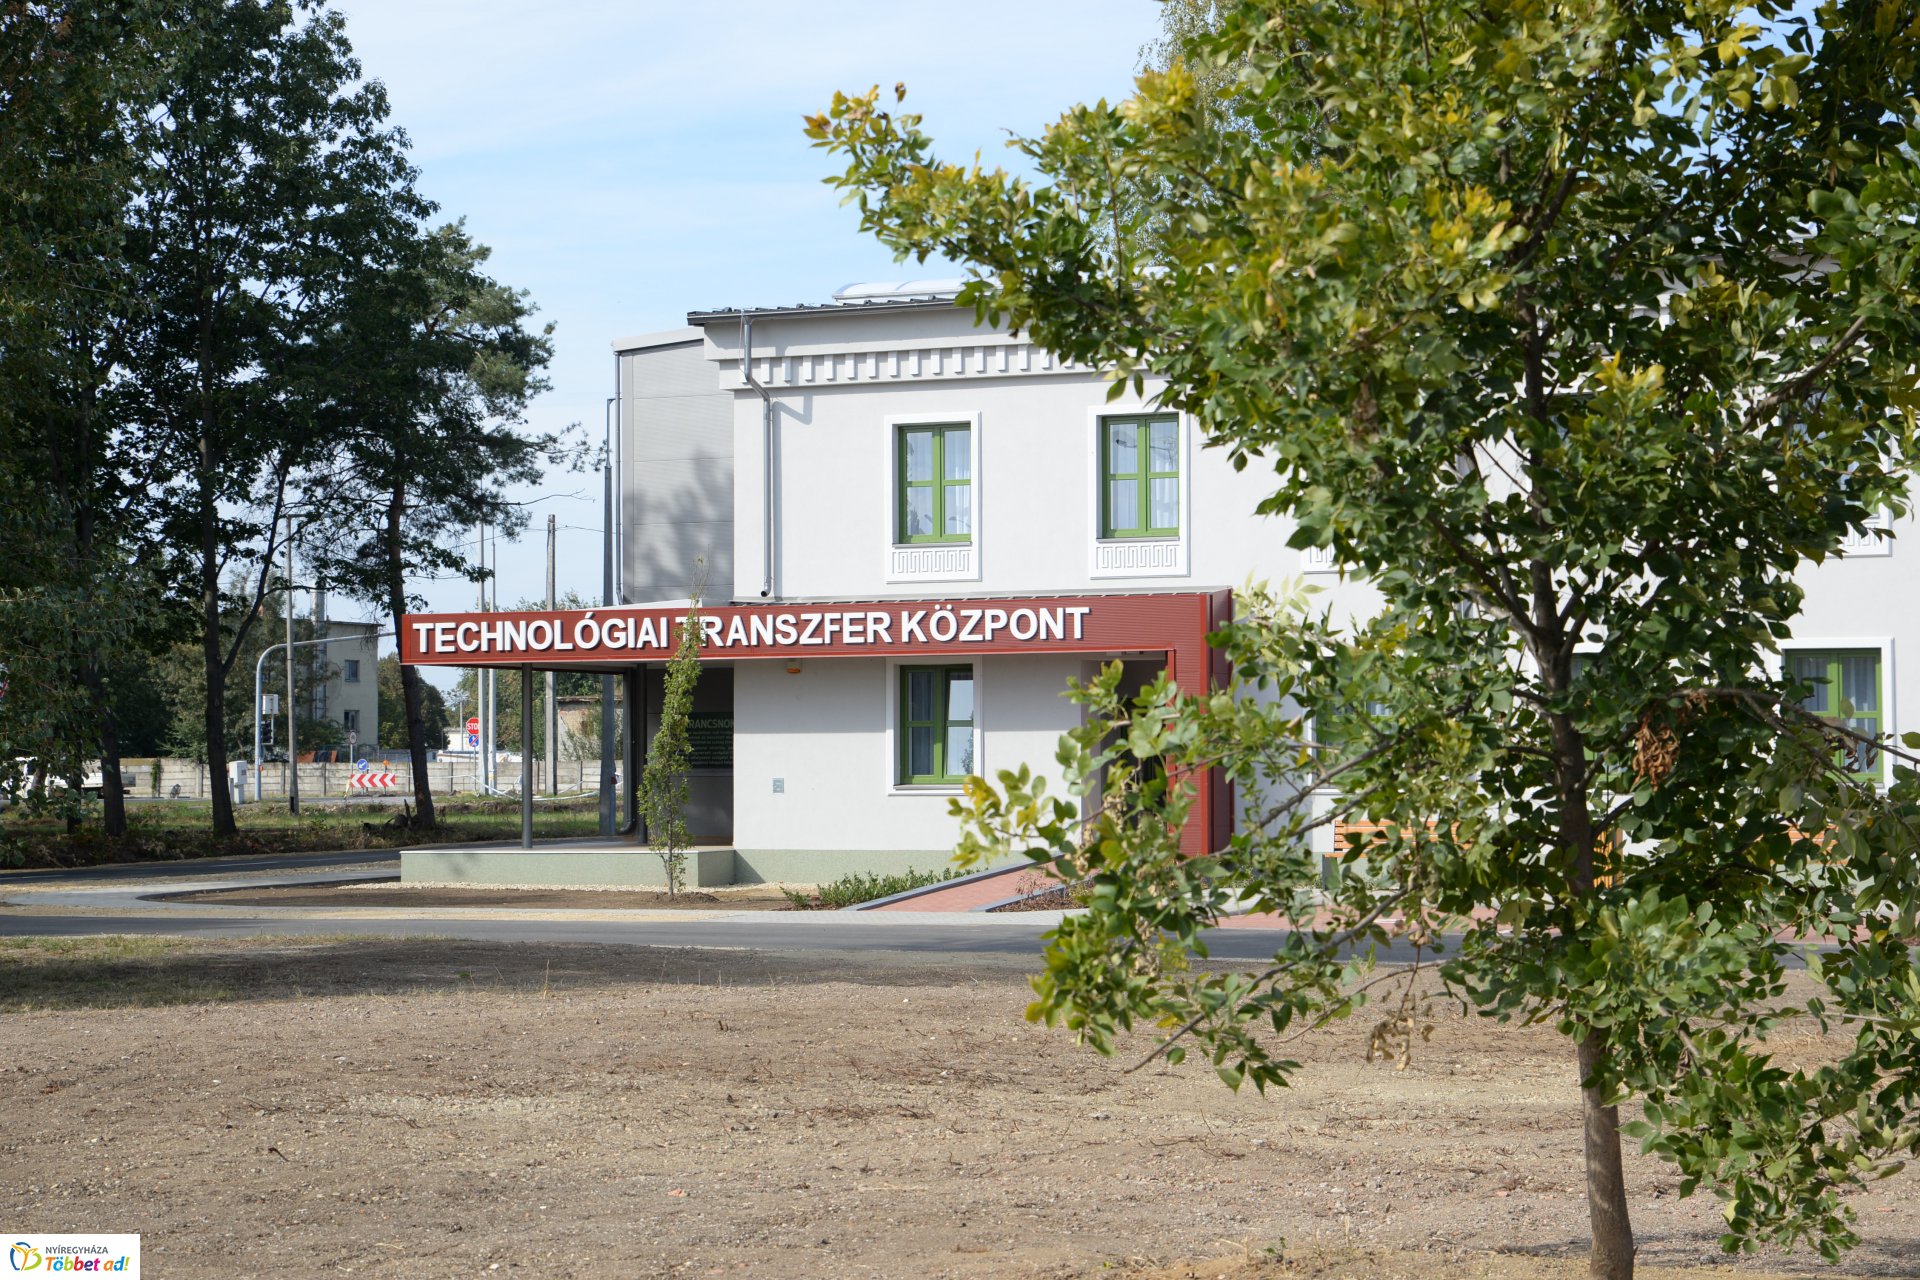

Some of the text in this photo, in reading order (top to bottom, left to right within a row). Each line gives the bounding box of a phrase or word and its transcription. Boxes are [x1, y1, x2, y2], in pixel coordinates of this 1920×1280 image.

[412, 604, 1090, 653] TECHNOLÓGIAI TRANSZFER KÖZPONT
[467, 722, 479, 730] STO
[686, 719, 734, 729] RANCSNO
